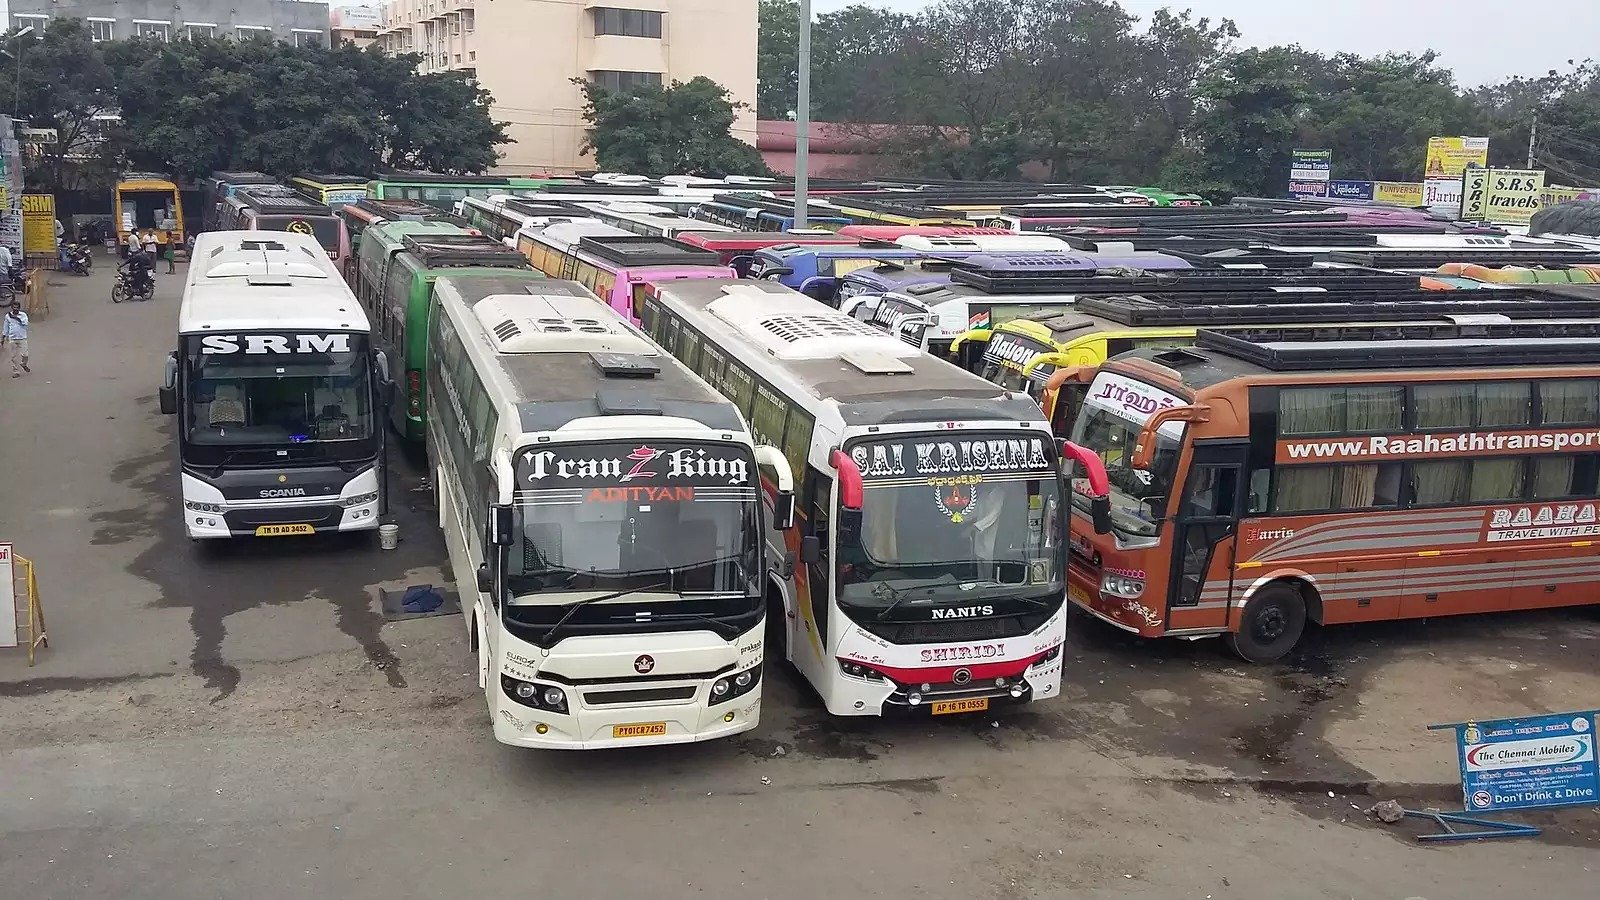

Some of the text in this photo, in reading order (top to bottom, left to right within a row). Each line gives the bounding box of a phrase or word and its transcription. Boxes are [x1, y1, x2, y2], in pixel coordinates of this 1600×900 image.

[1289, 182, 1325, 195] Soumya
[1383, 185, 1421, 195] UNIVERSAL
[1495, 177, 1538, 192] S.R.S.
[22, 196, 51, 212] SRM
[1489, 194, 1538, 209] travels
[202, 334, 351, 355] SRM
[852, 439, 1049, 476] SAI KRISHNA
[259, 487, 306, 498] SCANIA
[587, 486, 696, 503] ADITYAN
[1489, 503, 1600, 528] RAAHA
[1247, 526, 1294, 544] Harris
[1498, 528, 1545, 540] TRAVEL
[1549, 526, 1580, 537] WITH
[931, 604, 994, 620] NANI'S
[920, 643, 1006, 664] SHIRIDI
[937, 699, 985, 712] AP 16 TB 0555
[1479, 744, 1575, 761] The Chennai Mobiles
[1495, 792, 1523, 803] Don't
[1525, 789, 1552, 801] Drink
[1555, 790, 1563, 799] &
[1565, 787, 1593, 798] Drive
